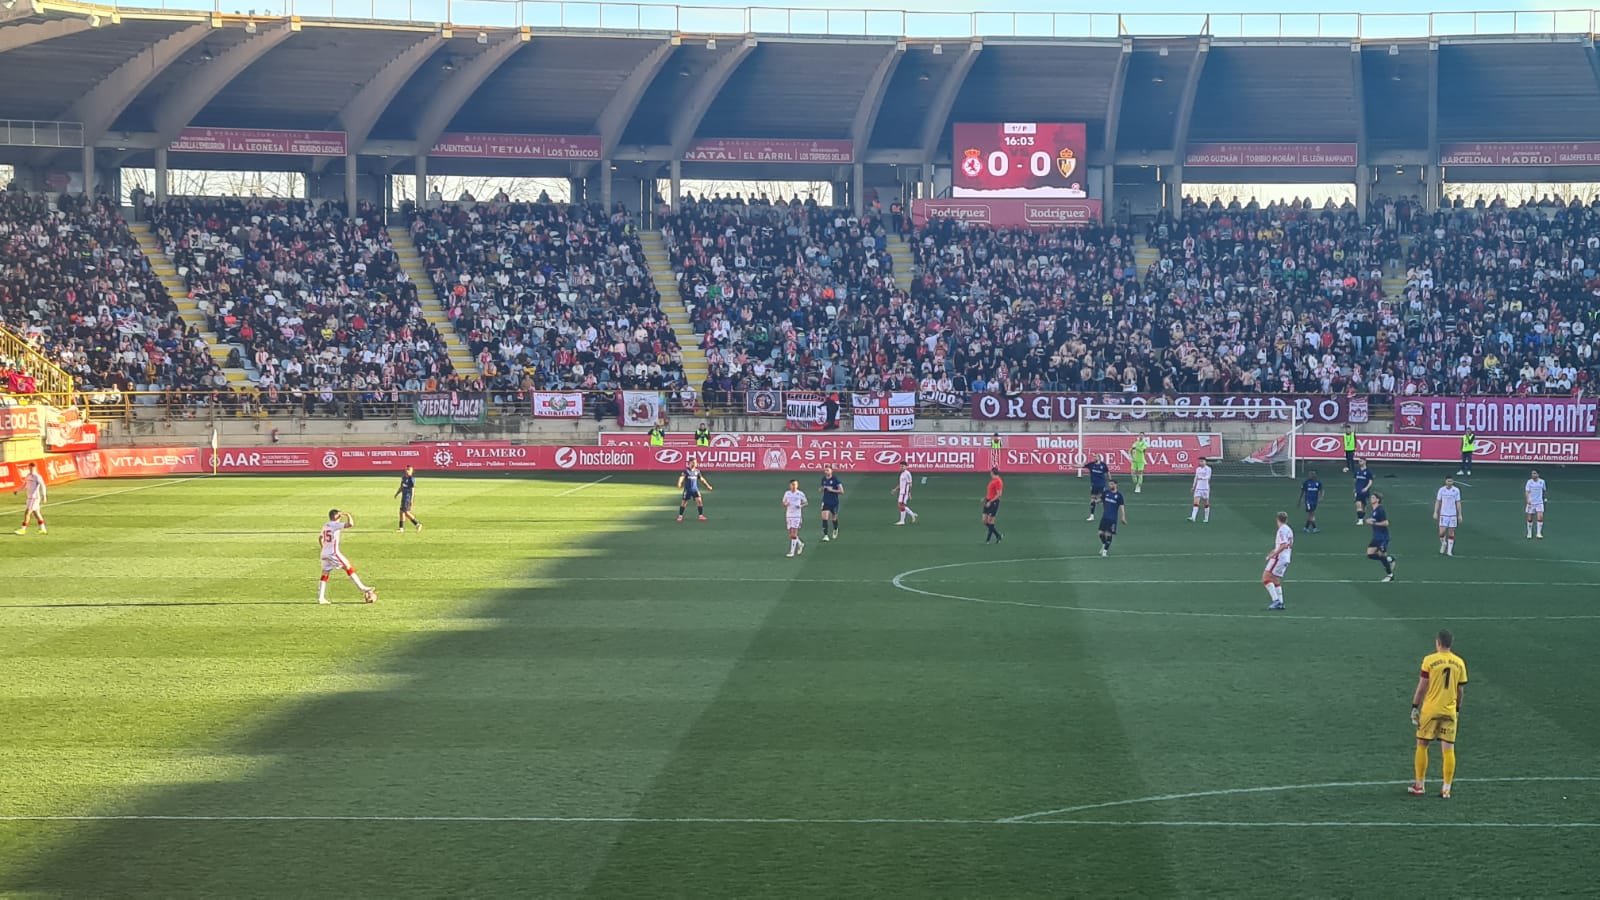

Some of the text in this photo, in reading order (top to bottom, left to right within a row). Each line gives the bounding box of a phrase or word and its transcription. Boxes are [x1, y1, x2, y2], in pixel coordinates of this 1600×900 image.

[1004, 136, 1035, 146] 16:03
[232, 143, 244, 151] LA
[246, 143, 284, 153] LEONESA
[490, 144, 541, 154] TETUÁN
[547, 148, 563, 157] LOS
[685, 151, 737, 160] NATAL
[743, 152, 793, 160] EL BARRIL
[1441, 155, 1493, 164] BARCELONA
[1501, 155, 1552, 164] MADRID
[988, 151, 1009, 177] 0
[1030, 151, 1051, 177] 0
[787, 402, 817, 419] GUZMÁN
[854, 407, 915, 415] CULTURALISTAS
[1430, 399, 1597, 433] EL LEÓN RAMPANTE
[890, 418, 914, 427] 1923
[747, 435, 766, 443] AAR
[1356, 439, 1422, 452] YUNDAI
[1500, 441, 1579, 455] HYUNDAI
[466, 447, 527, 458] PALMERO
[686, 450, 756, 462] HYUNDAI
[790, 449, 866, 462] ASPIRE
[905, 451, 975, 463] HYUNDAI
[1007, 448, 1088, 465] SEÑORÍO
[110, 454, 196, 468] VITALDENT
[222, 452, 261, 467] AAR
[1442, 667, 1451, 690] 1
